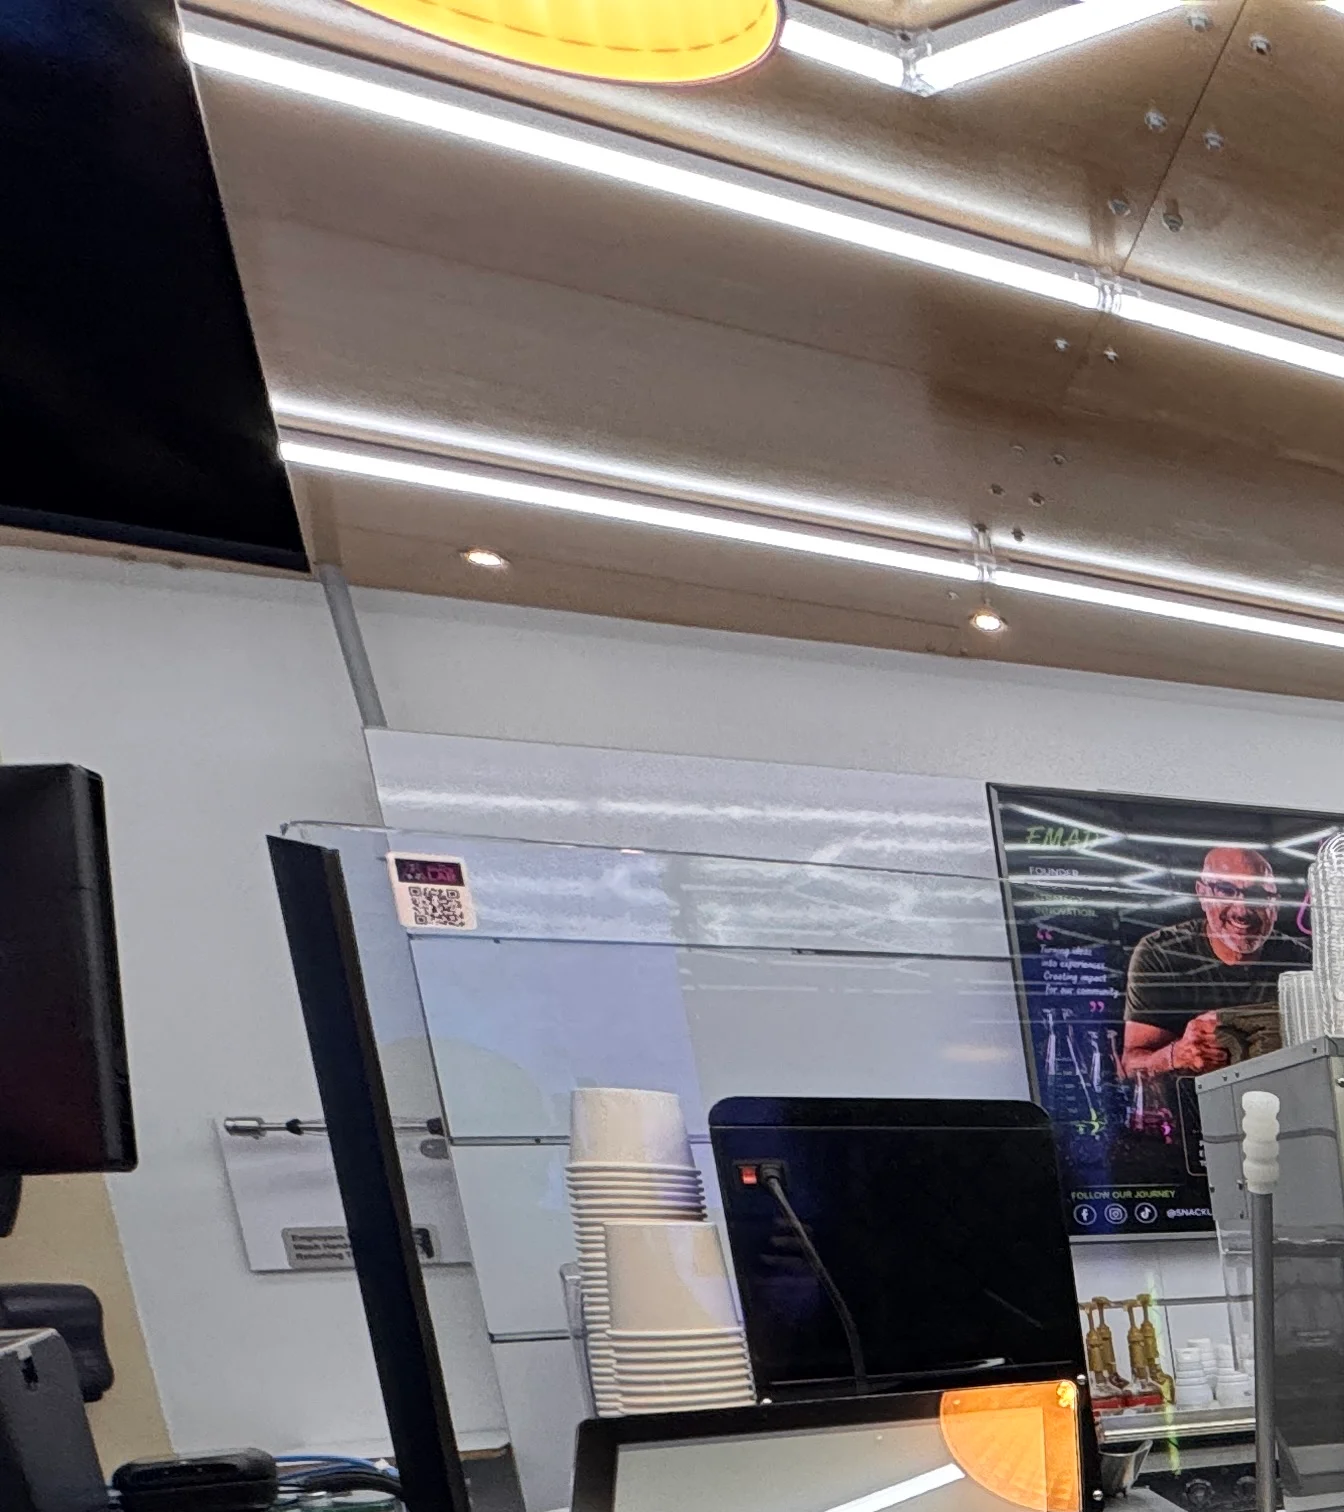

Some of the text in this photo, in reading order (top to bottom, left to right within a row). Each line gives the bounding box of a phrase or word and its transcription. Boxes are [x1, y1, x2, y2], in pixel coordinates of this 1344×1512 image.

[1071, 1189, 1176, 1200] FOLLOW OUR JOURNEY
